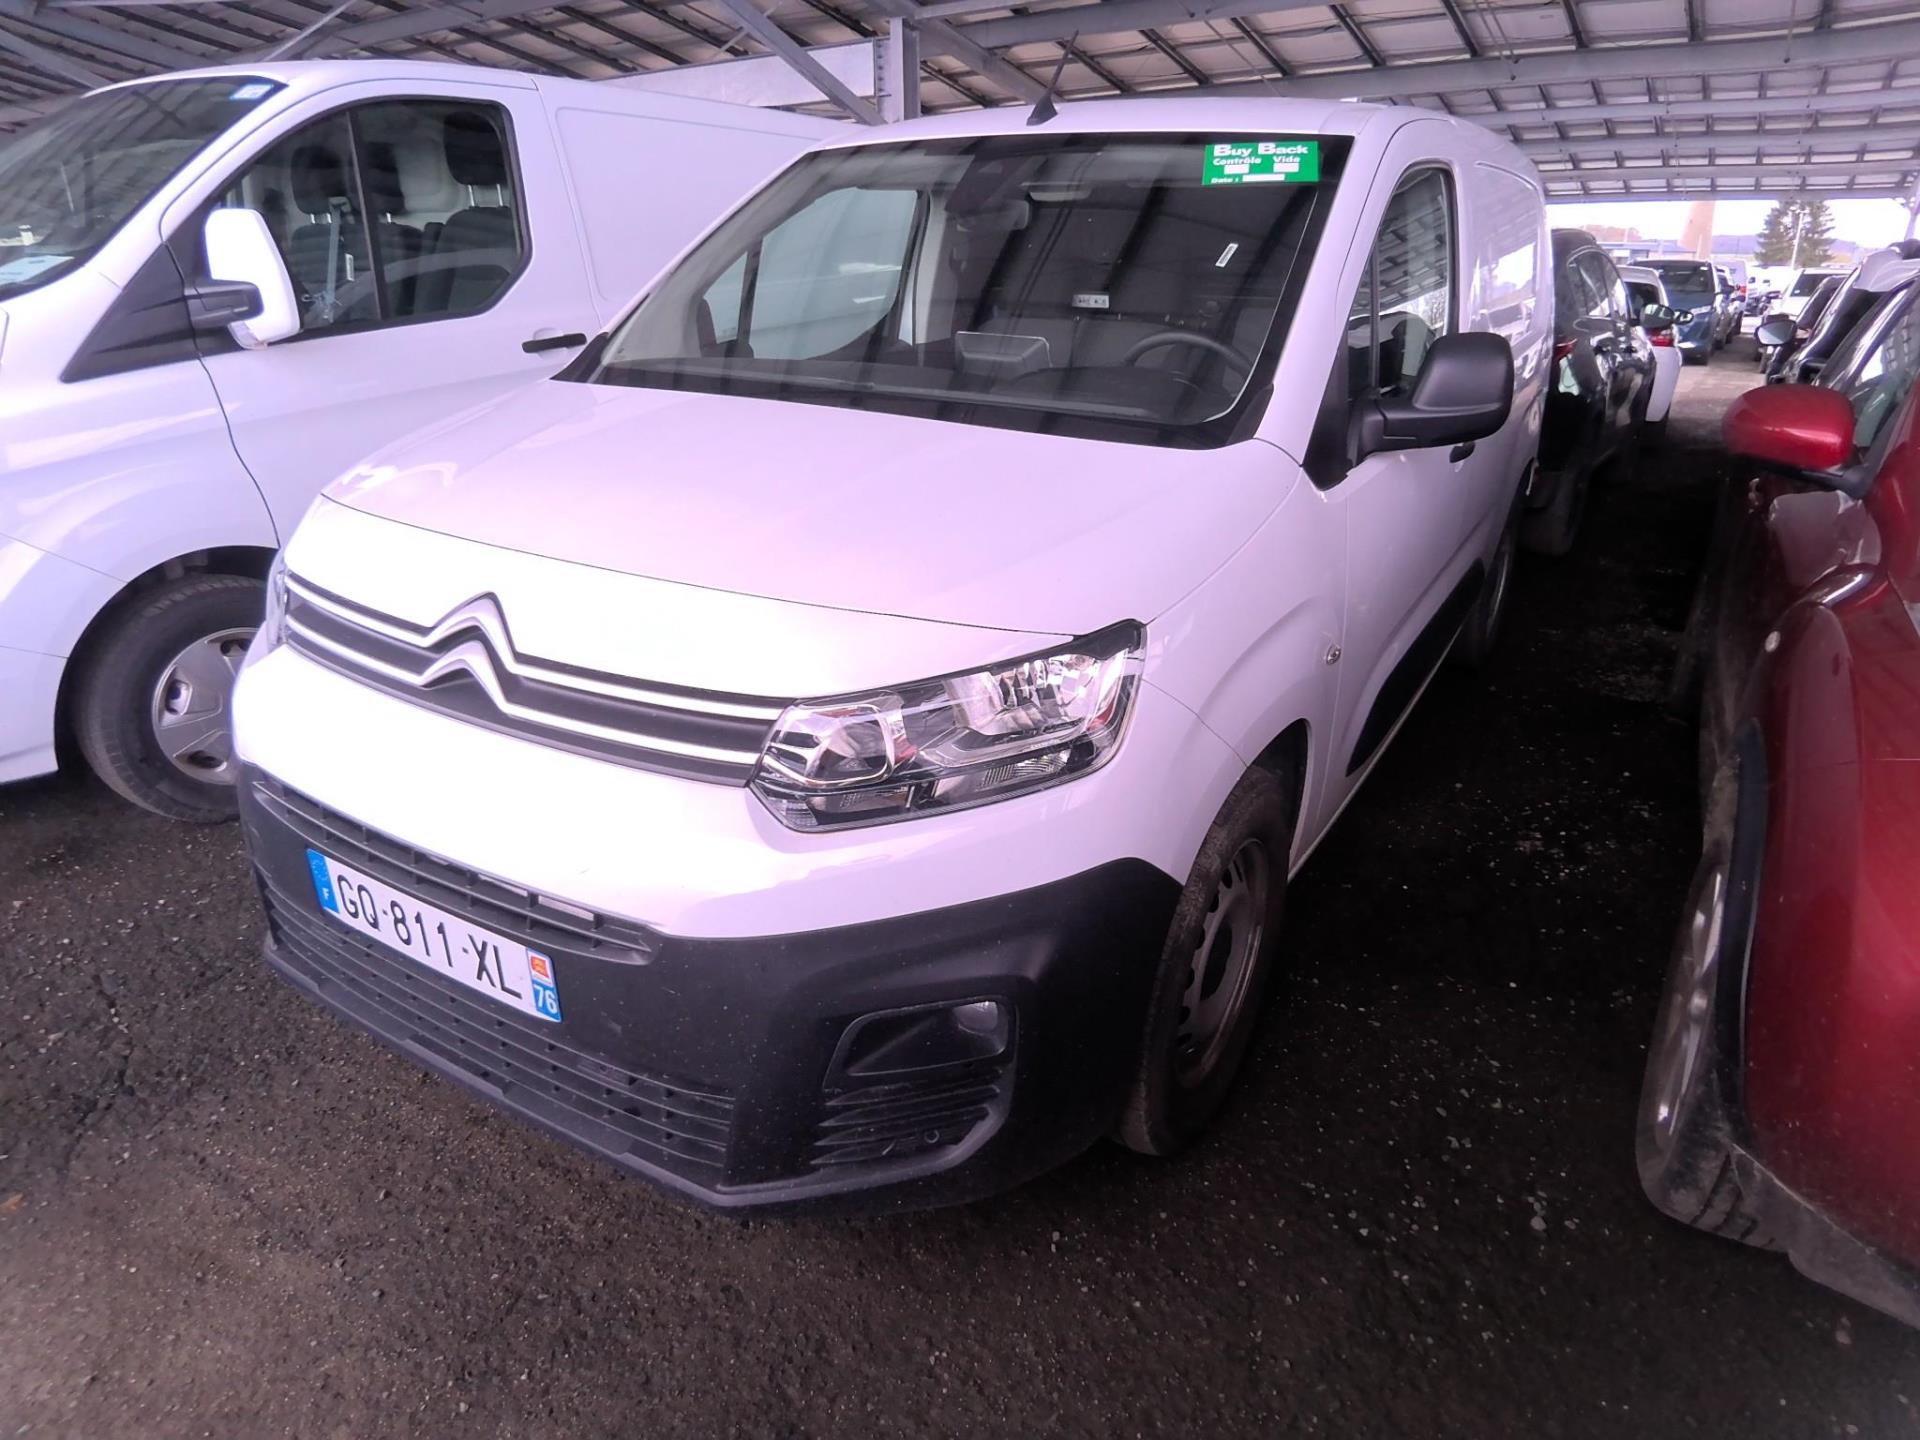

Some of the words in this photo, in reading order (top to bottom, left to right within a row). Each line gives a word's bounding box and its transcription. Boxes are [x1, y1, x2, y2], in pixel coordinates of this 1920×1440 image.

[1213, 144, 1252, 157] Buy
[1258, 142, 1309, 155] Back
[1272, 155, 1301, 163] Vide
[337, 874, 523, 1000] GQ-811-XL
[533, 983, 558, 1015] 76
